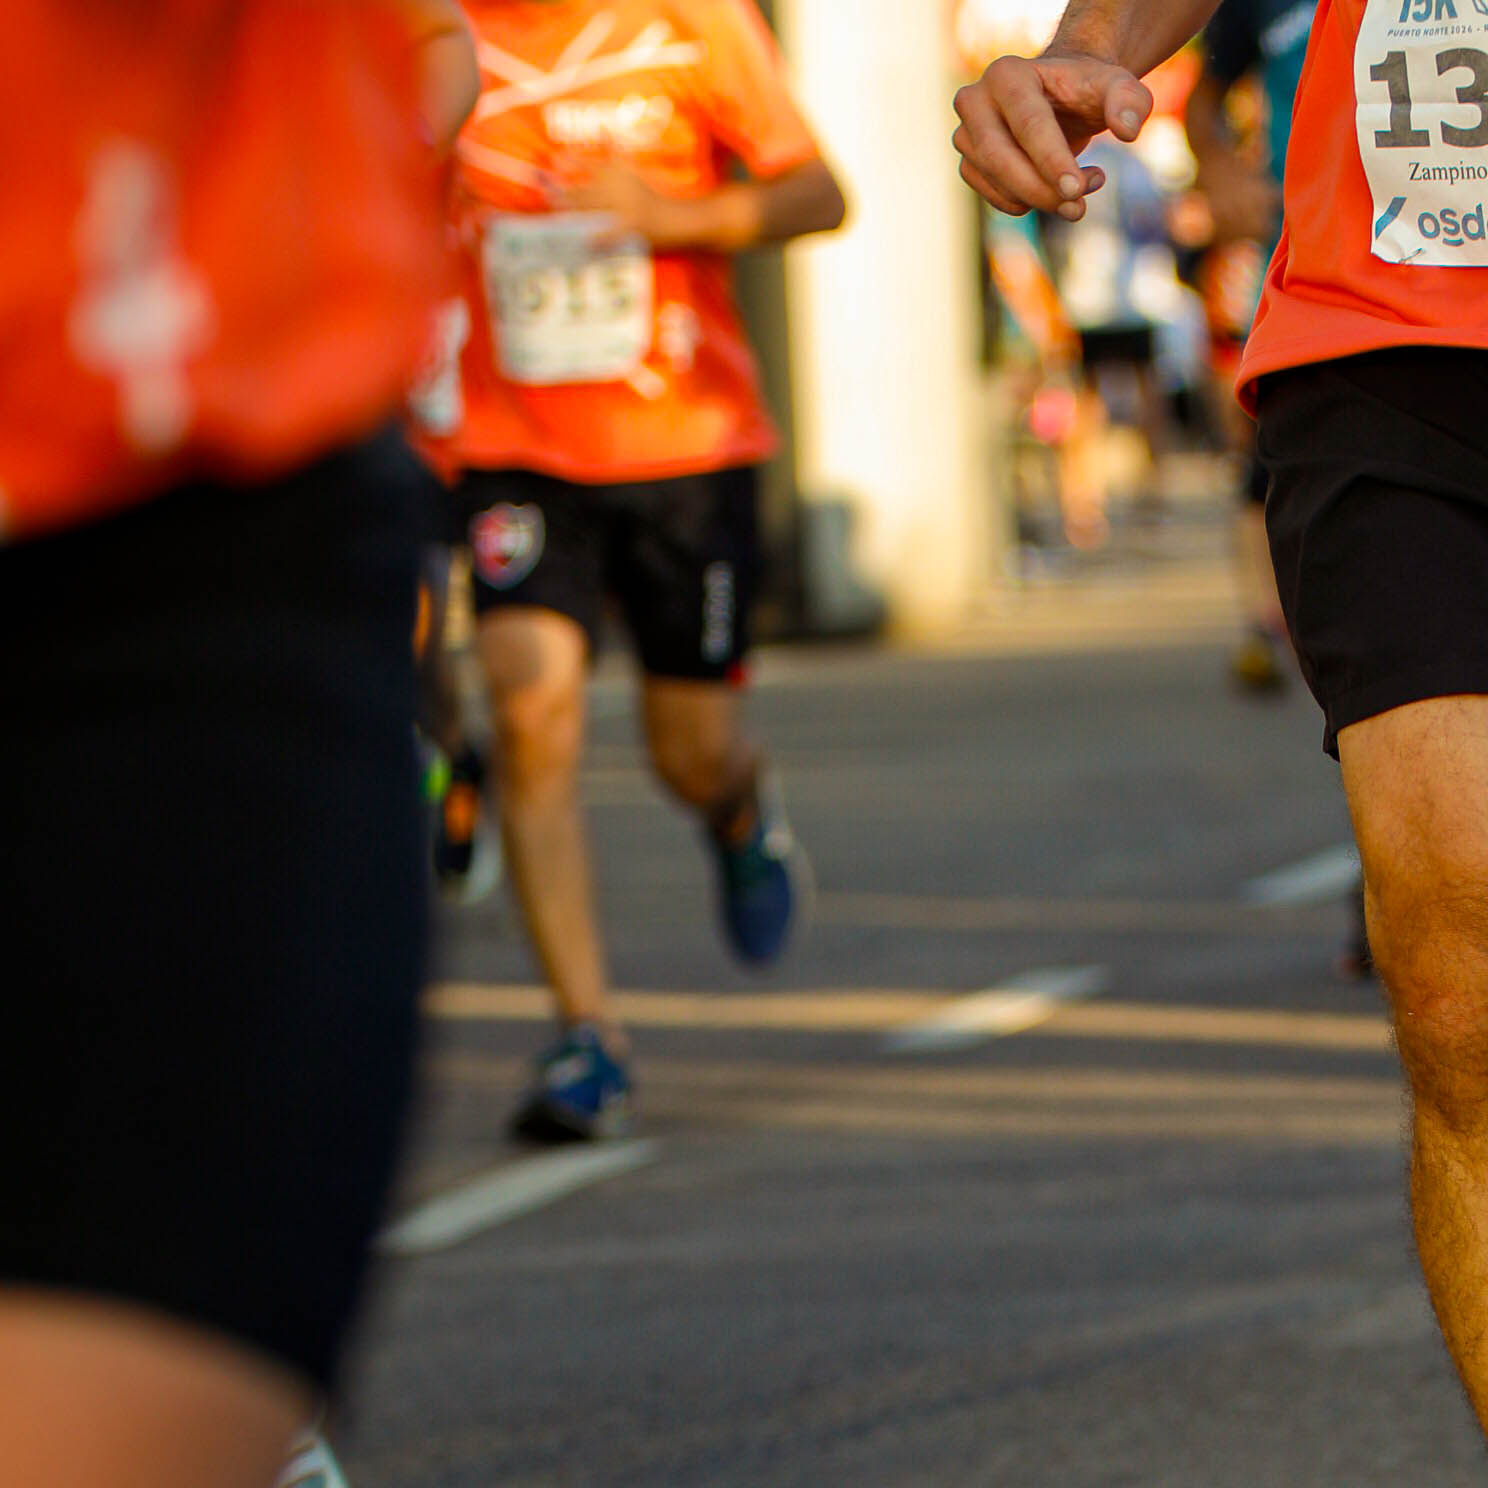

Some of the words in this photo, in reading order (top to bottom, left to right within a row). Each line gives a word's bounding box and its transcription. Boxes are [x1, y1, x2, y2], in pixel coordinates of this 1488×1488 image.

[1387, 28, 1421, 38] PUERTO
[1423, 27, 1449, 37] NORTE
[1408, 161, 1488, 185] Zampino
